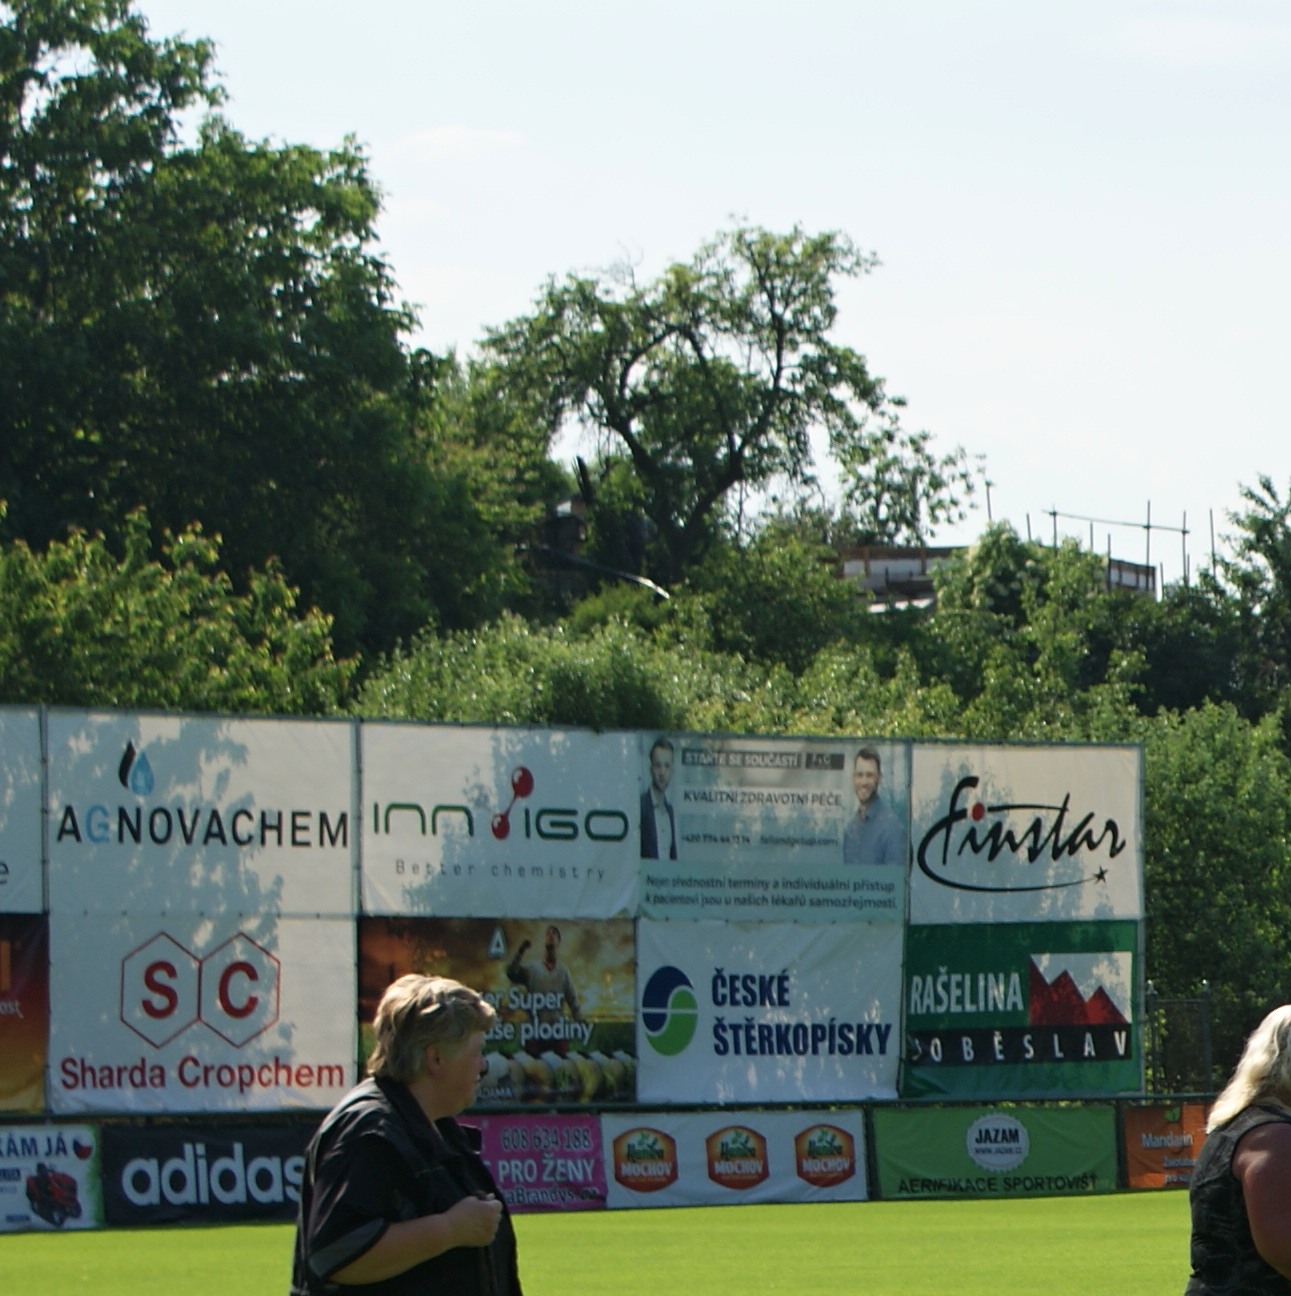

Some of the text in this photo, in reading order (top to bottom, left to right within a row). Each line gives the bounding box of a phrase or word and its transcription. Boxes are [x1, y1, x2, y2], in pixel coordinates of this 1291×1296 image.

[56, 803, 349, 849] AGNOVACHEM
[396, 859, 606, 882] Better chemistry
[141, 960, 259, 1019] S C
[508, 985, 565, 1016] Super
[711, 966, 791, 1007] ČESKÉ
[910, 966, 1024, 1015] RAŠELINA
[520, 1017, 595, 1046] plodiny
[712, 1011, 892, 1057] ŠTĚRKOPÍSKY
[60, 1056, 346, 1093] Sharda Cropchem
[44, 1131, 69, 1158] JÁ
[974, 1128, 1020, 1145] JAZAM
[121, 1141, 306, 1207] adidas
[498, 1152, 595, 1183] PRO ŽENY
[897, 1177, 999, 1194] AERIFIKACE
